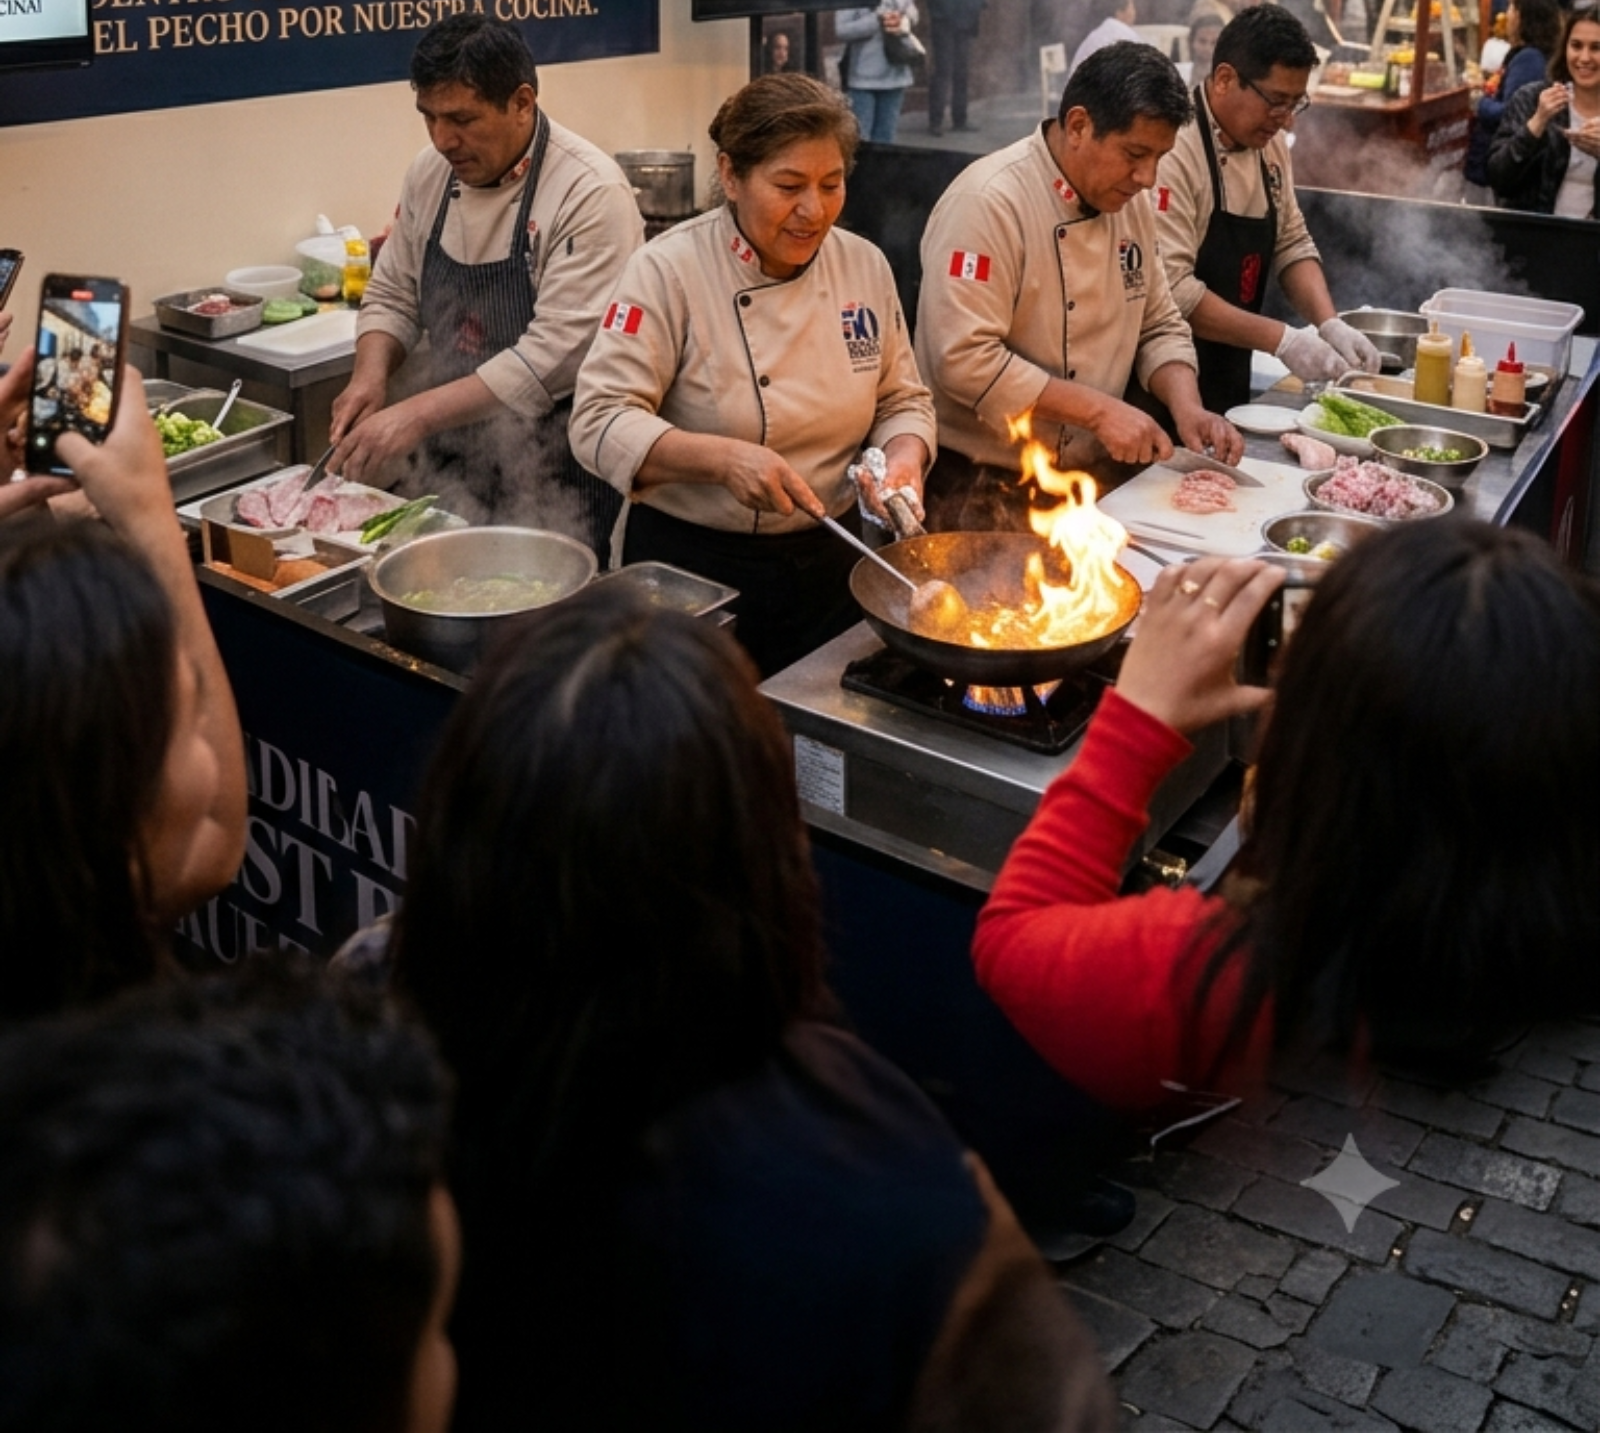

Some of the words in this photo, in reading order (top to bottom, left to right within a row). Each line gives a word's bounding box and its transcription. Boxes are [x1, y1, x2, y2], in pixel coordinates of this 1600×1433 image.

[93, 19, 139, 55] EL
[148, 9, 270, 50] PECHO
[278, 5, 346, 39] POR
